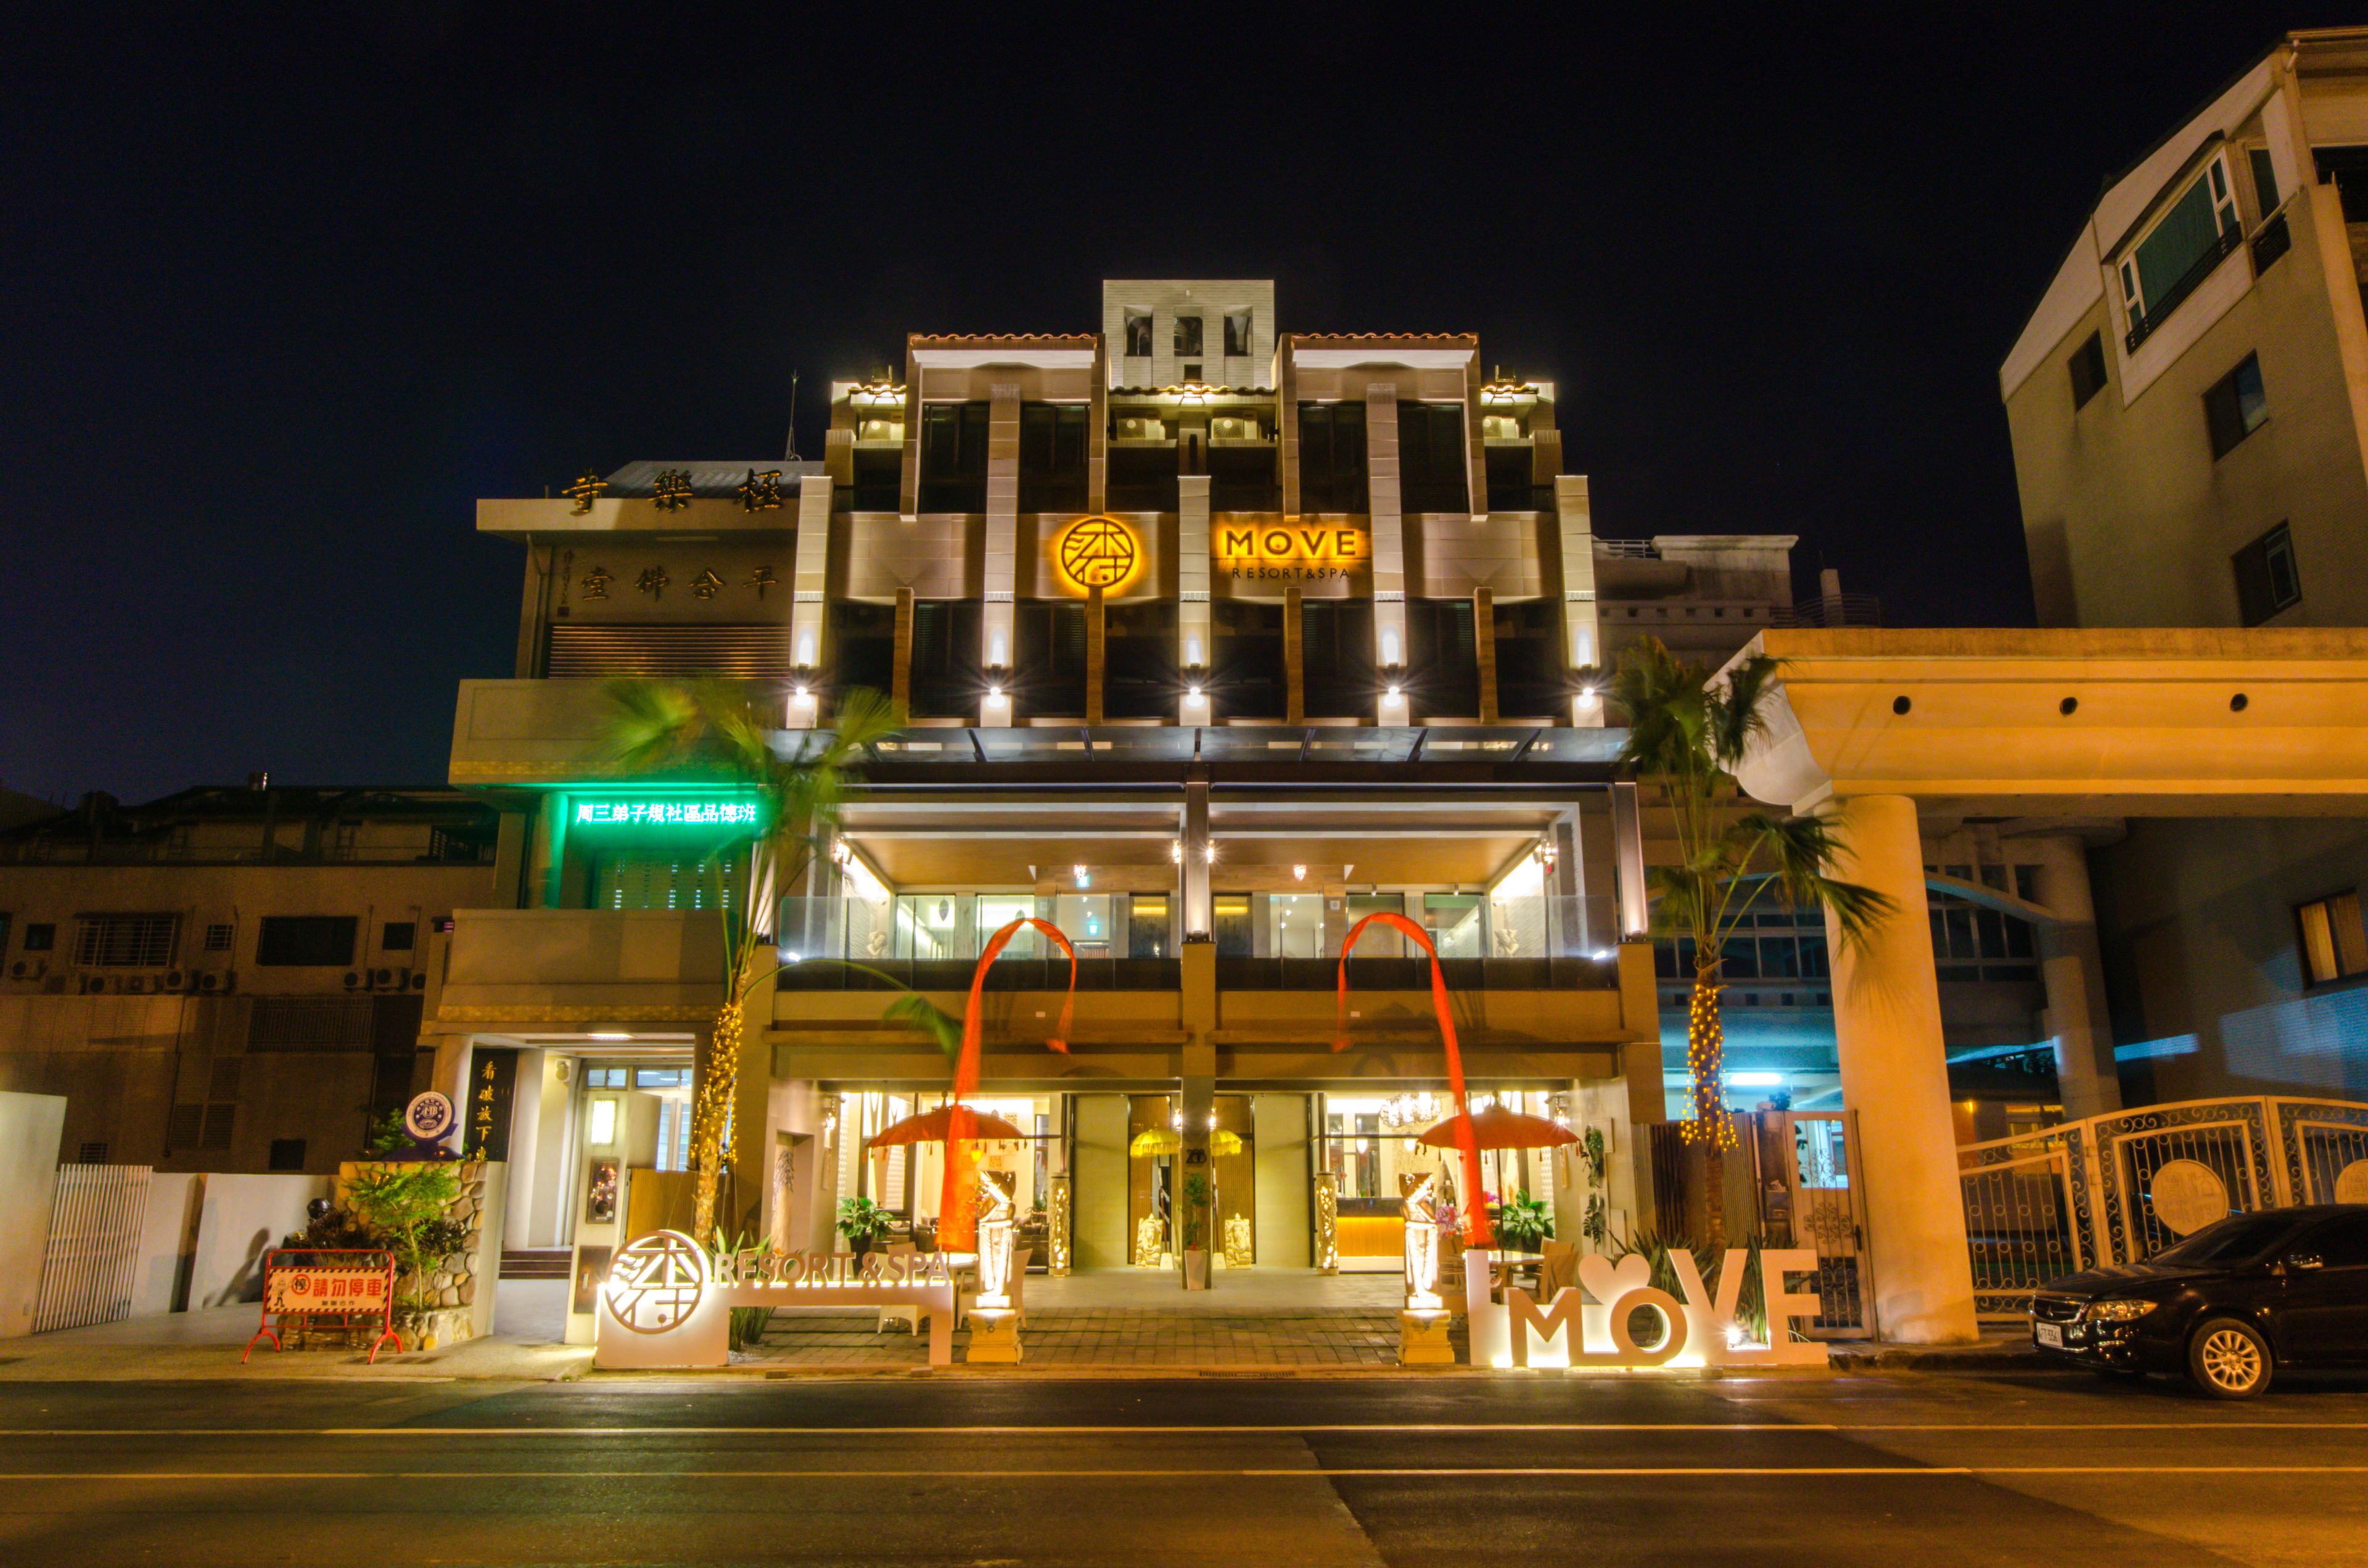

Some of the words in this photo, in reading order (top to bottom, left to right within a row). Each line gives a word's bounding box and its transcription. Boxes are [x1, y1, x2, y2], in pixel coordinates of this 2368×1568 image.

[1226, 530, 1355, 556] MOVE
[576, 803, 756, 823] 周三弟子規社區品德班
[313, 1278, 382, 1297] 請勿停車
